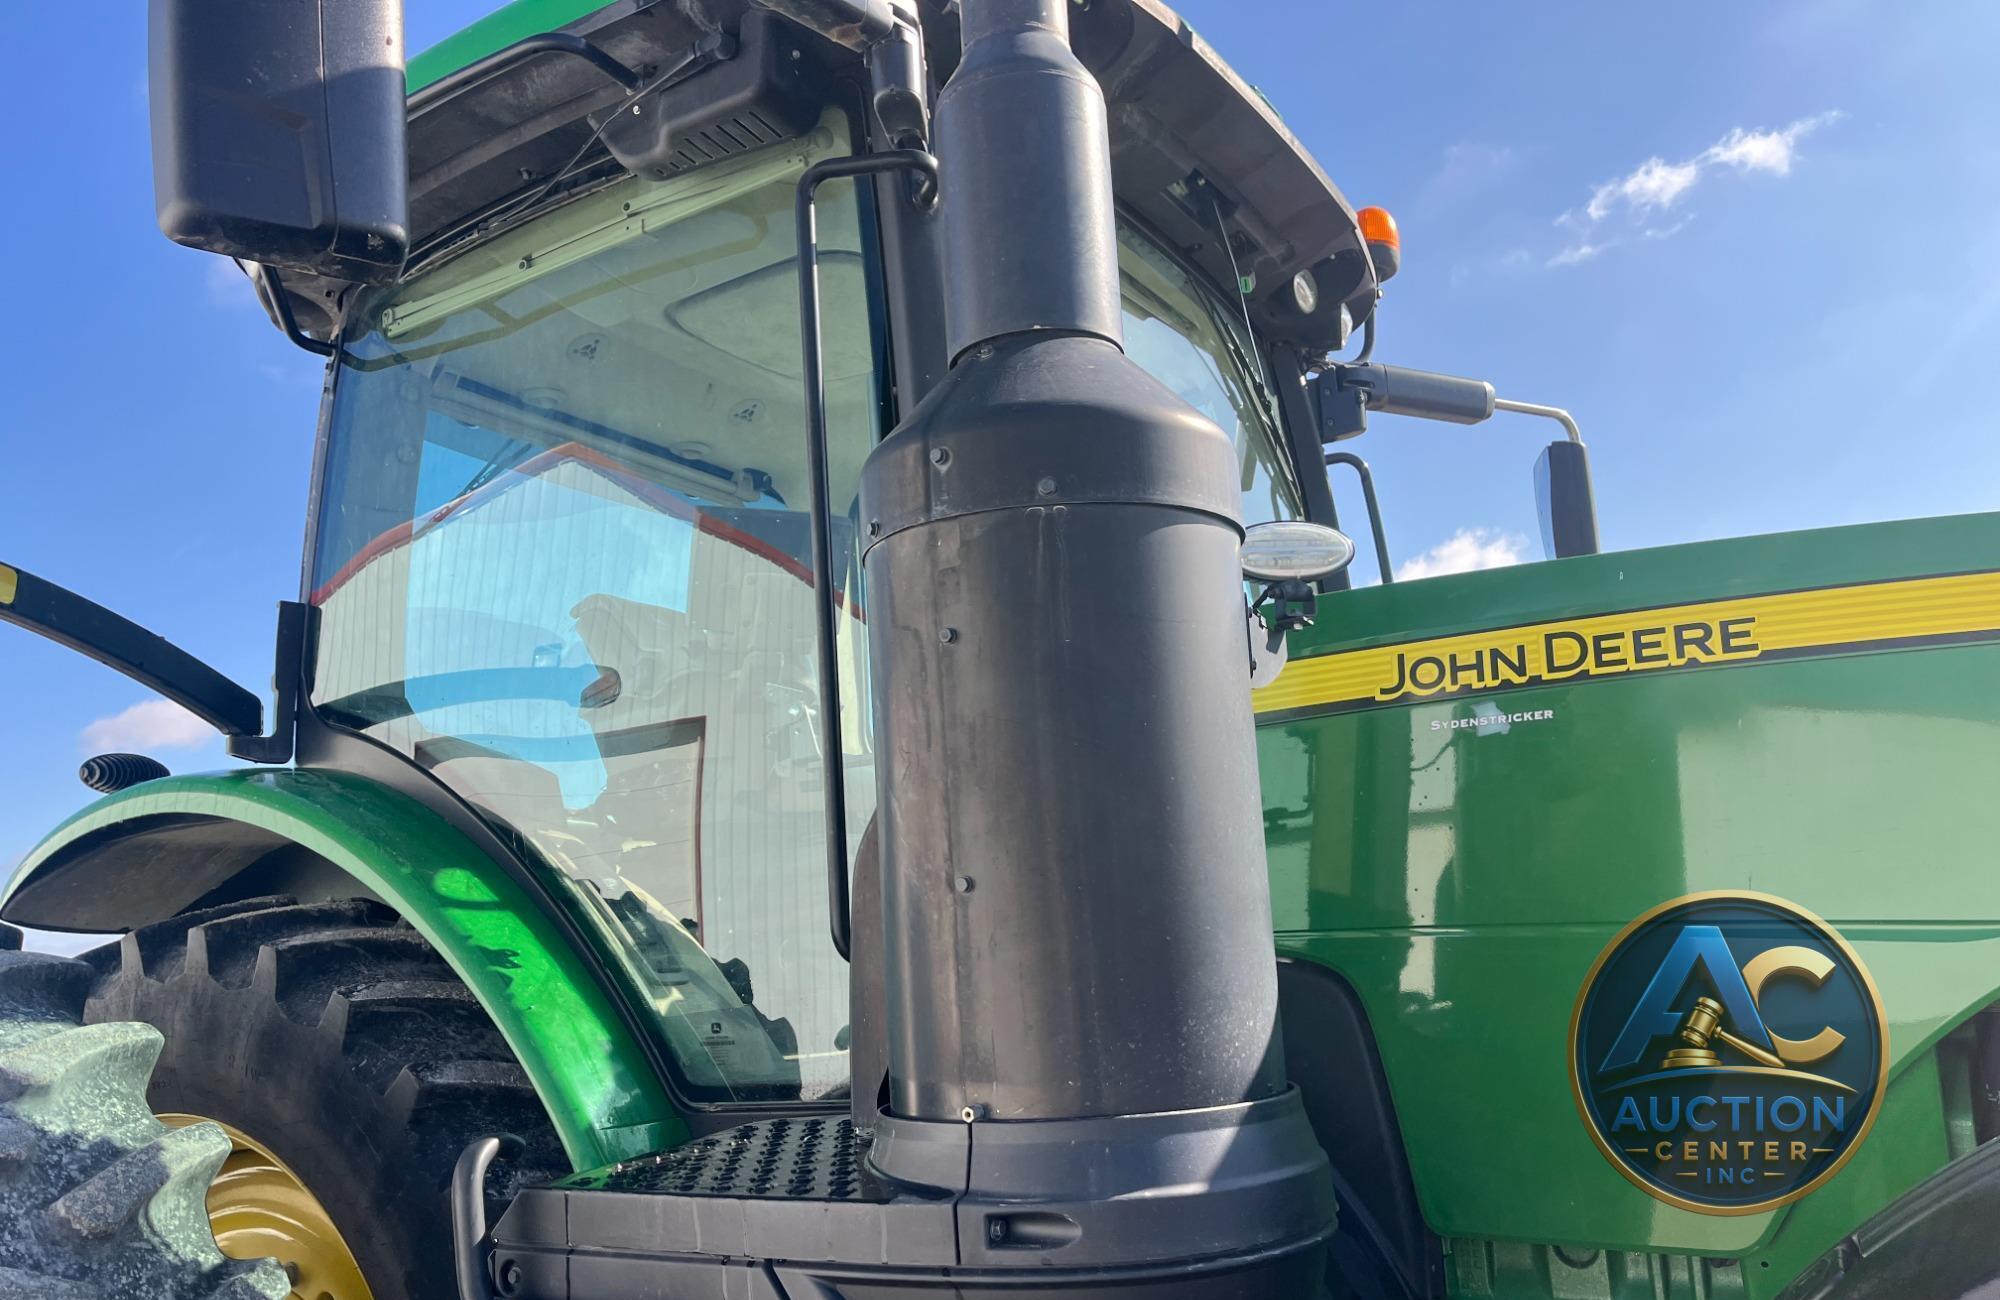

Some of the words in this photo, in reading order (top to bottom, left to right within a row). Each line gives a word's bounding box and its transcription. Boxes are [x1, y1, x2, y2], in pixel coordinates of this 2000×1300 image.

[1379, 643, 1528, 695] JOHN
[1544, 617, 1759, 674] DEERE
[1430, 709, 1554, 731] SYDENSTRICKER
